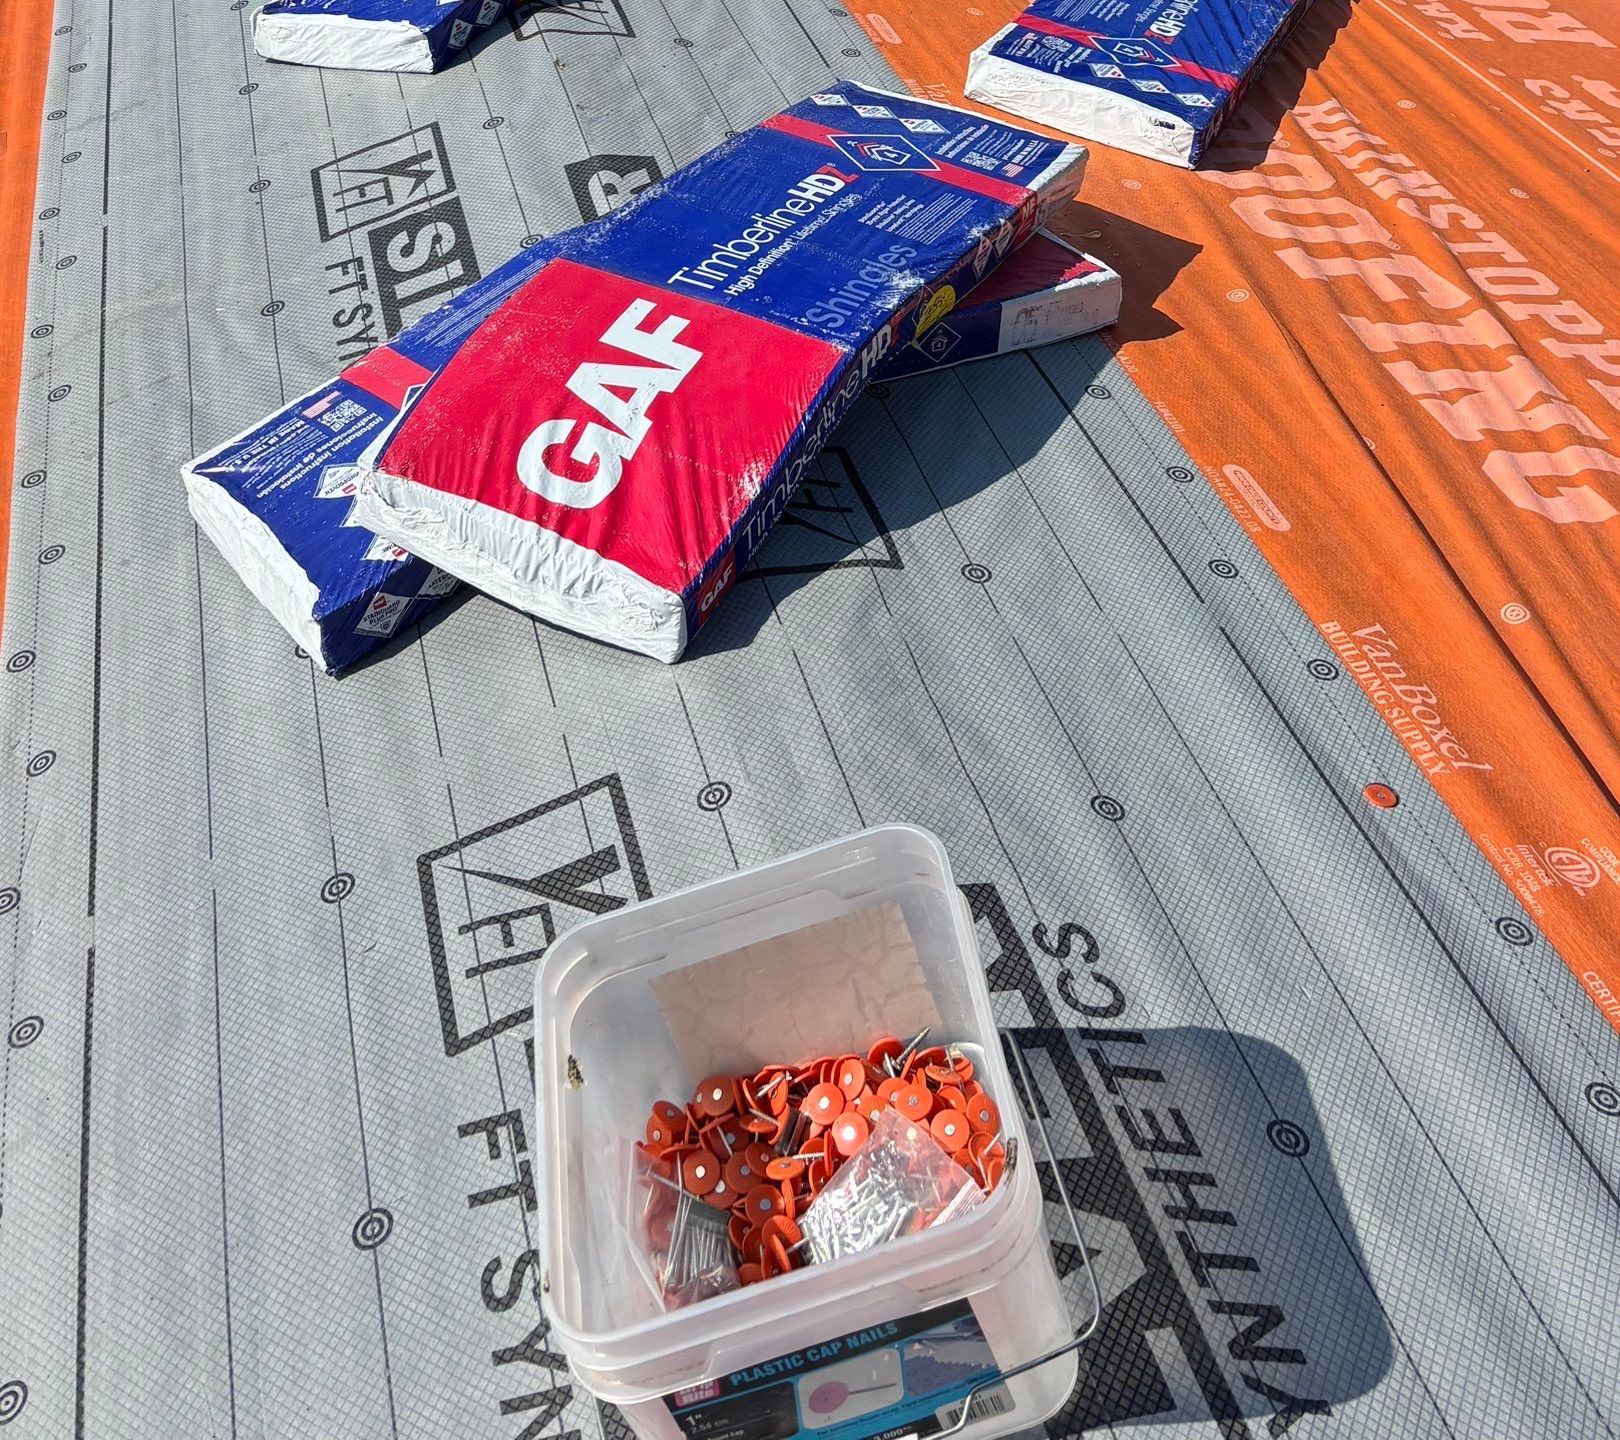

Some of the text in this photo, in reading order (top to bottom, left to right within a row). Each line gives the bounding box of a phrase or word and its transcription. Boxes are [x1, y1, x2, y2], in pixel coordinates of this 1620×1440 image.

[667, 165, 860, 291] TimberlineHDZ
[724, 271, 752, 297] High
[750, 237, 796, 280] Definition
[806, 243, 918, 330] Shingles
[516, 296, 703, 509] GAF
[700, 562, 735, 613] GAF
[1319, 620, 1451, 777] BUILDING SUPPLY
[1480, 833, 1504, 862] Control
[1517, 844, 1554, 887] Intertek
[1583, 970, 1620, 1022] CERTIF
[457, 1108, 540, 1213] FT
[1032, 921, 1336, 1440] YNTHETICS
[729, 1322, 899, 1388] PLASTIC CAP NAILS
